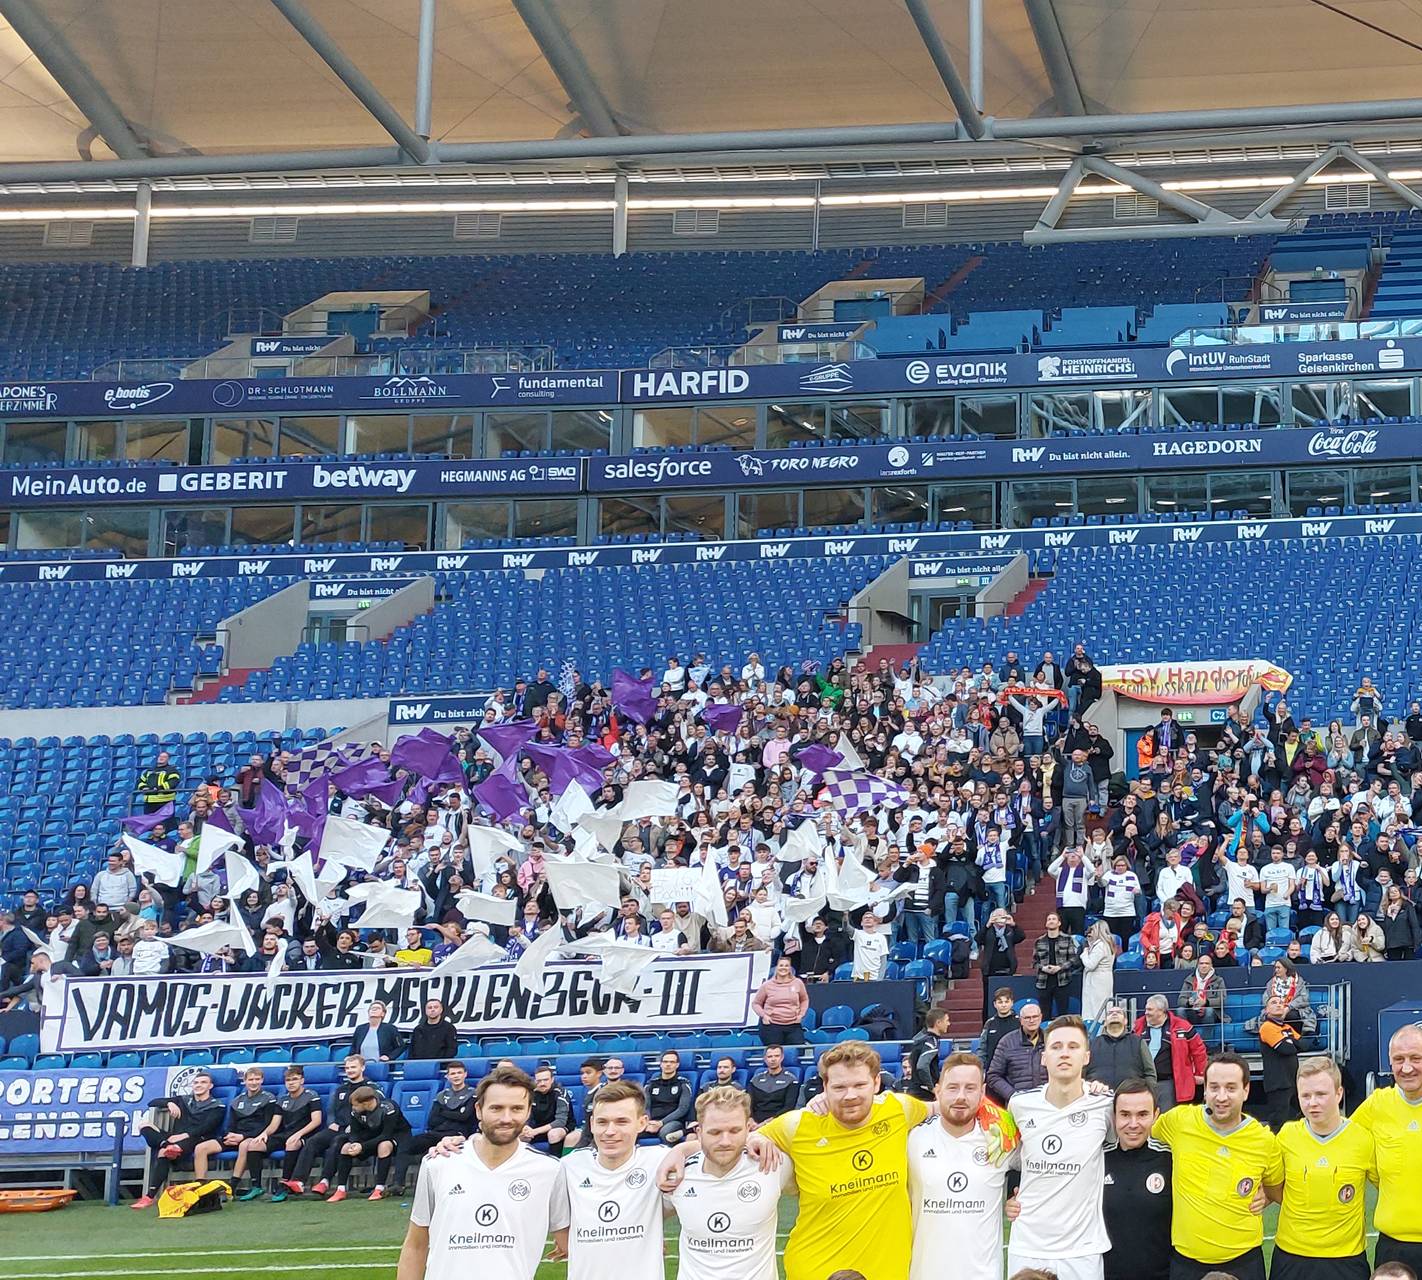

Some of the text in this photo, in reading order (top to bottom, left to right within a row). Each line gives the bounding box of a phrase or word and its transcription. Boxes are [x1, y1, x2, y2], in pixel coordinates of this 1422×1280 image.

[1265, 309, 1288, 319] R+V
[1062, 356, 1132, 365] ROHSTOFFHANDEL
[1189, 352, 1270, 365] IntUV RuhrStadt
[1298, 353, 1354, 363] Sparkasse
[936, 361, 1007, 376] EVONIK
[1298, 362, 1374, 374] Gelsenkirchen
[519, 376, 603, 389] fundamental
[633, 370, 749, 396] HARFID
[374, 387, 447, 397] BOLLMANN
[518, 390, 555, 398] consulting
[1013, 447, 1046, 462] R+V
[1063, 453, 1077, 461] bist
[1080, 452, 1099, 460] nicht
[1102, 451, 1130, 459] allein.
[1153, 439, 1262, 456] HAGEDORN
[604, 457, 712, 482] salesforce
[771, 455, 859, 471] TORO NEGRO
[181, 471, 287, 491] GEBERIT
[313, 465, 416, 493] betway
[441, 469, 526, 483] HEGMANNS AG
[12, 475, 146, 496] MeinAuto.de
[1302, 522, 1332, 535] R+V
[980, 535, 1010, 549] R+V
[632, 549, 663, 563] R+V
[305, 559, 336, 573] R+V
[915, 562, 942, 575] R+V
[316, 583, 345, 596] R+V
[1117, 667, 1161, 684] TSV
[1168, 665, 1254, 682] Handorf
[396, 703, 484, 720] R+V Du bist nich
[1212, 711, 1225, 720] C2
[830, 1172, 899, 1194] Kneilmann
[924, 1199, 985, 1209] Kneilmann
[577, 1224, 644, 1238] Kneilmann
[687, 1237, 754, 1249] Kneilmann
